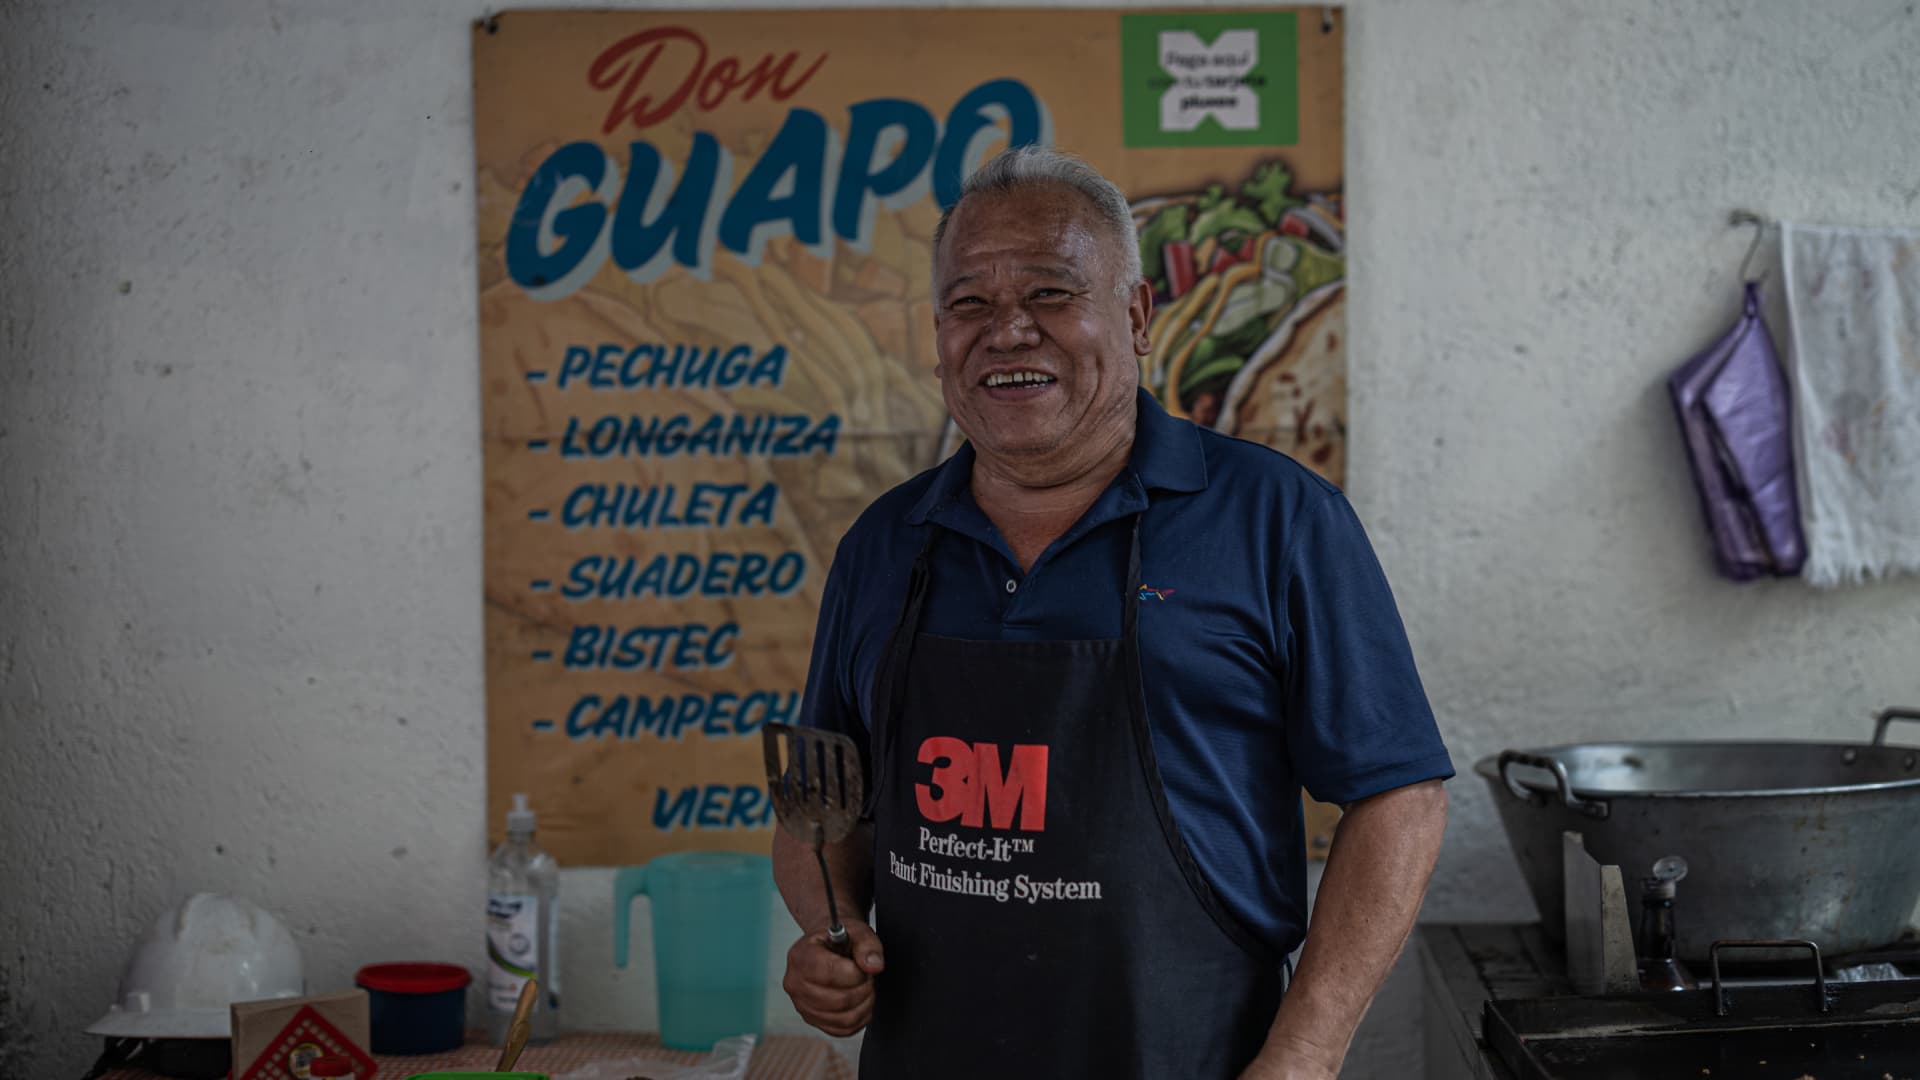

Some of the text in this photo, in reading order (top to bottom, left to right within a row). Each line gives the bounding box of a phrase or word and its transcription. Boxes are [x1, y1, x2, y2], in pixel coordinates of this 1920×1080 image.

[588, 26, 829, 134] Don
[506, 78, 1048, 292] GUAPO
[557, 344, 787, 389] PECHUGA
[560, 413, 840, 456] LONGANIZA
[561, 482, 777, 527] CHULETA
[561, 552, 805, 598] SUADERO
[563, 622, 740, 669] BISTEC
[565, 690, 802, 738] CAMPECH
[915, 736, 1049, 832] 3M
[889, 851, 1102, 904] Paint Finishing System
